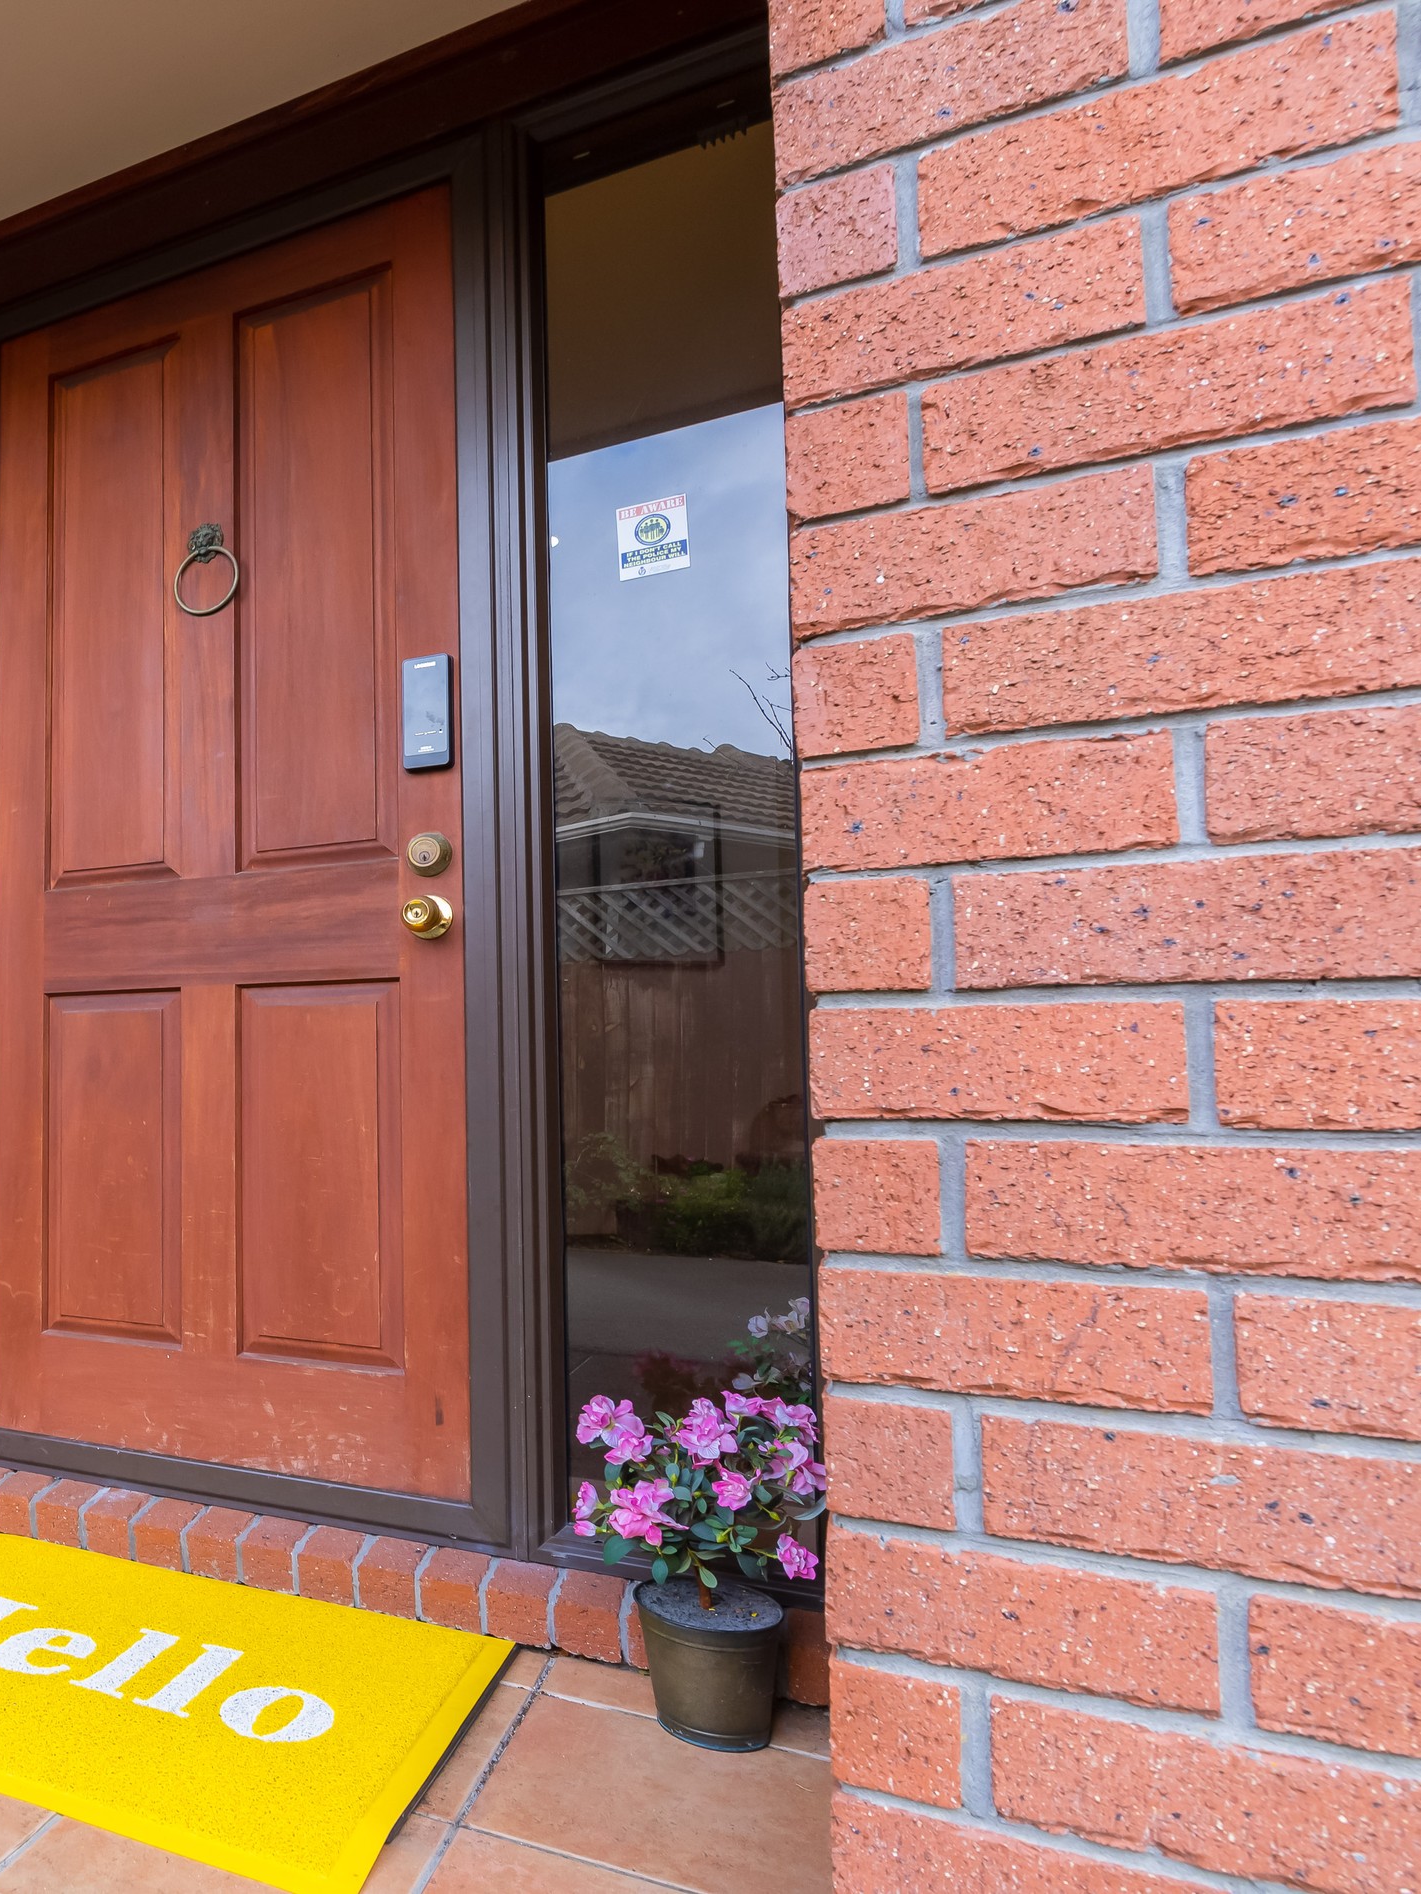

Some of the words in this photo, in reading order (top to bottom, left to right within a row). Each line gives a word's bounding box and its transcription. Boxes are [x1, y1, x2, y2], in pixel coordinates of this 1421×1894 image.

[620, 508, 637, 519] BE
[641, 497, 684, 514] AWARE
[663, 541, 682, 549] CALL
[623, 554, 667, 568] NEIGHBOUR
[668, 550, 686, 559] WILL
[627, 555, 641, 563] THE
[642, 549, 669, 559] POLICE
